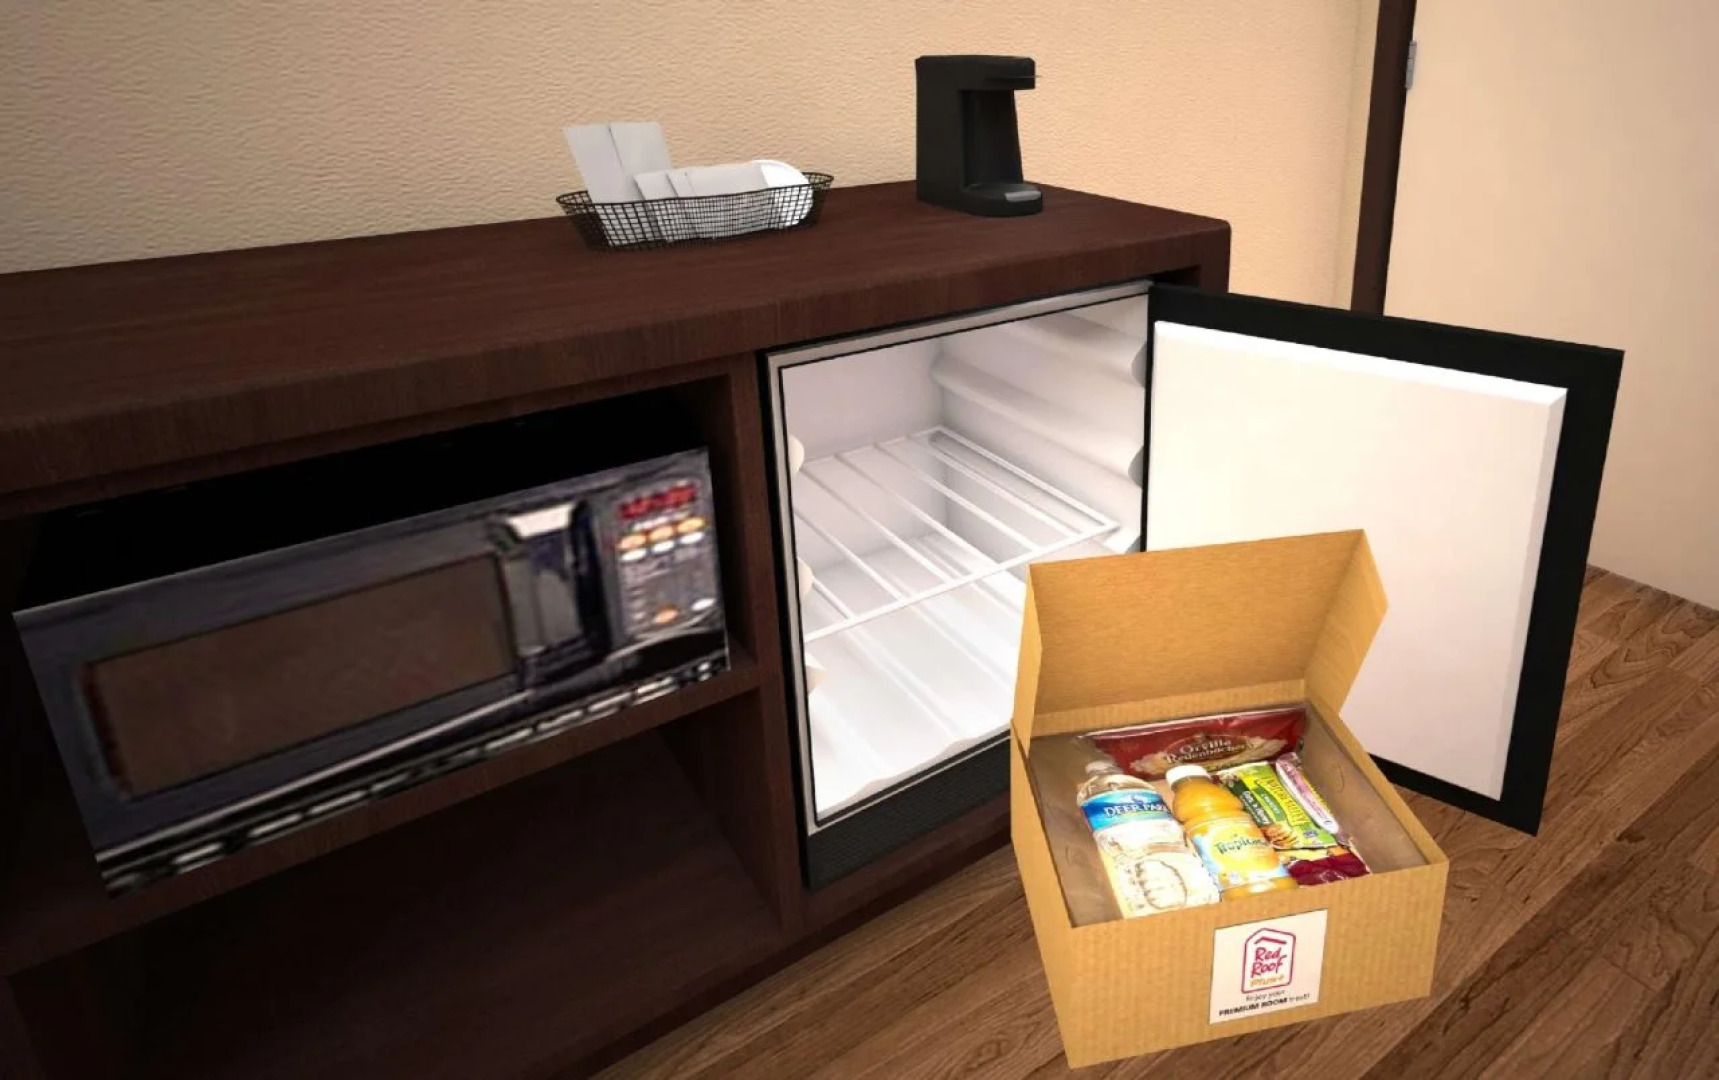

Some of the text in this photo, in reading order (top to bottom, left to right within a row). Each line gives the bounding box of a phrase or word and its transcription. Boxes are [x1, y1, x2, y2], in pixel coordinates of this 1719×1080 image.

[1103, 804, 1141, 818] DEER
[1255, 946, 1282, 961] Red
[1251, 954, 1287, 979] Roof
[1219, 1002, 1260, 1016] PREMIUM
[1261, 997, 1287, 1007] ROOM
